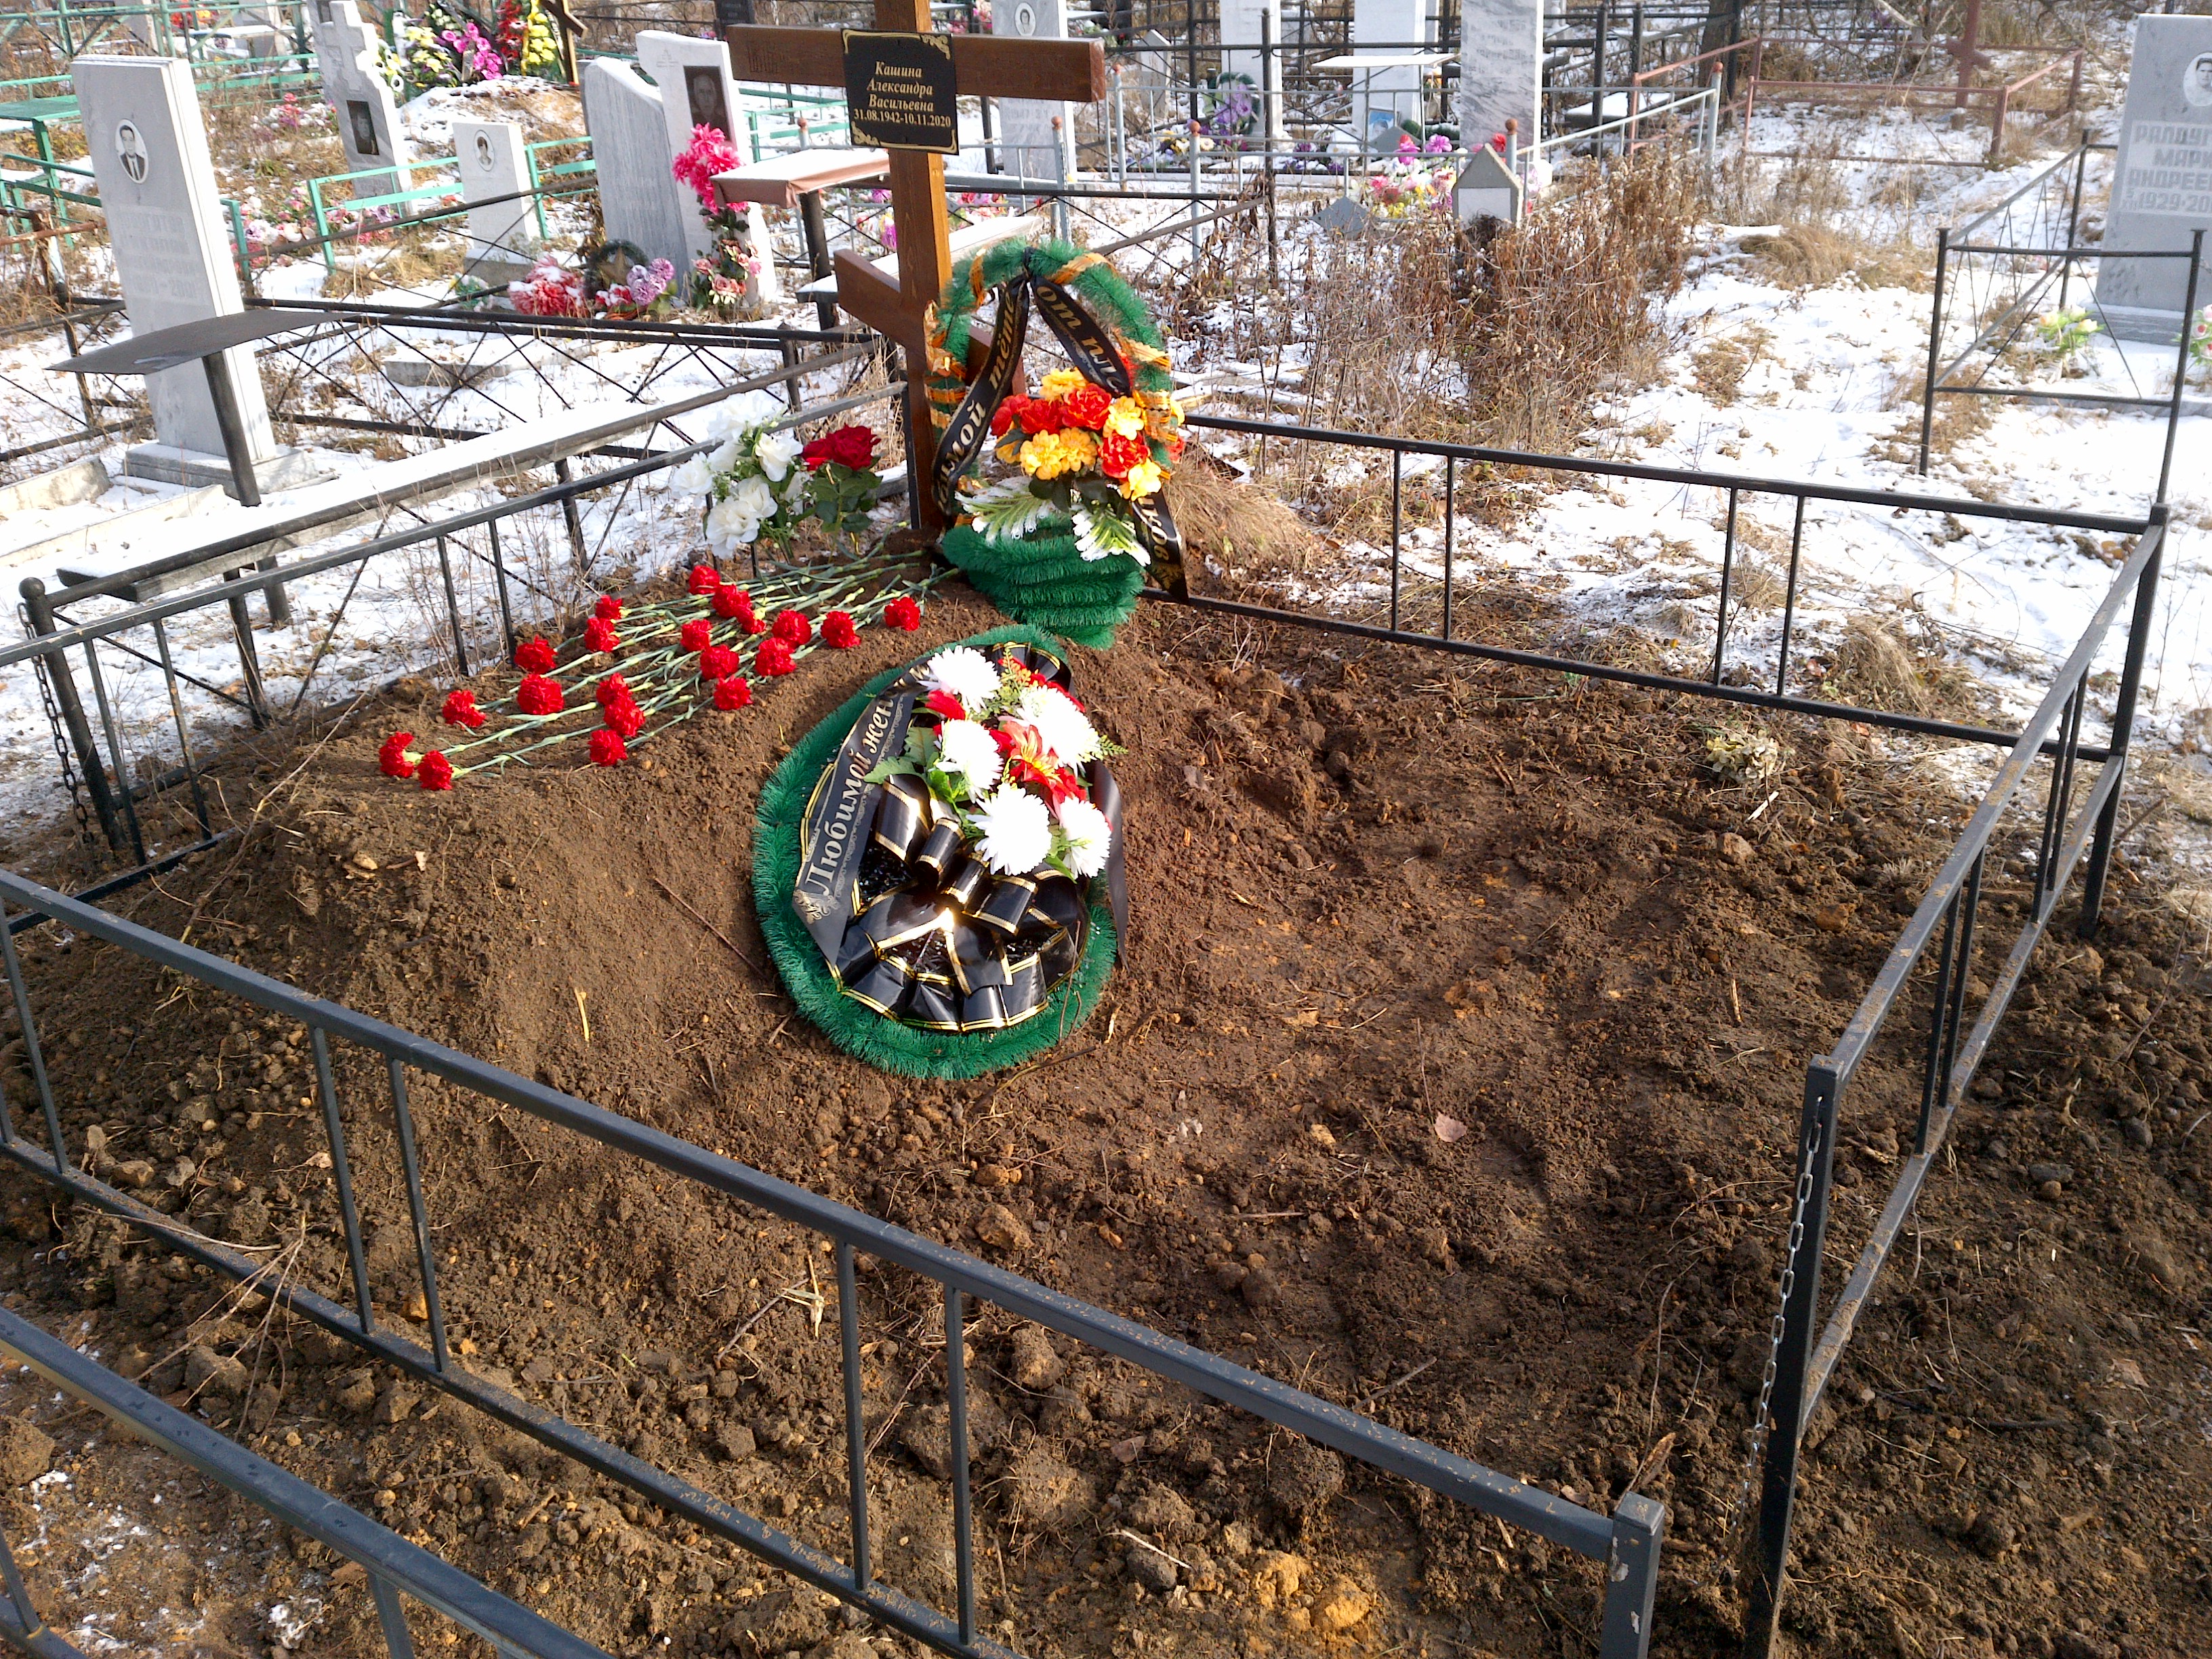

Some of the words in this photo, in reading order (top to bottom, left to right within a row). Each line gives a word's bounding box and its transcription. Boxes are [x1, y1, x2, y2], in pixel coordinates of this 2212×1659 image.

[875, 61, 922, 78] Кашина
[867, 77, 933, 98] Александра
[869, 94, 934, 112] Васильевна
[854, 108, 951, 127] 31.08.1942-10.11.2020
[2128, 169, 2212, 190] АНДРЕЕ
[805, 747, 872, 895] Любимой
